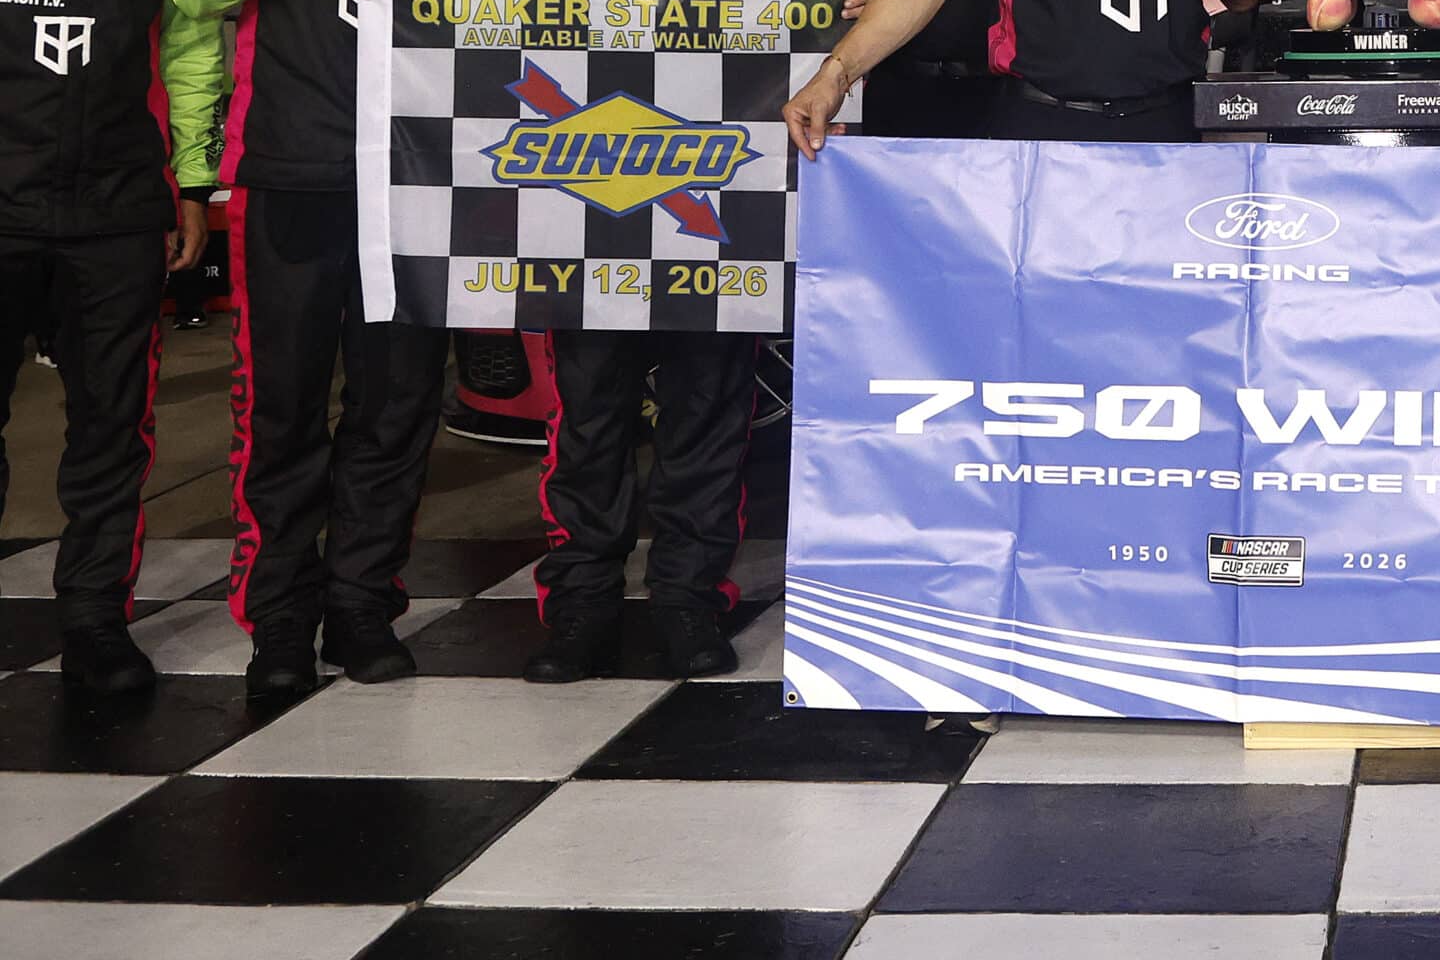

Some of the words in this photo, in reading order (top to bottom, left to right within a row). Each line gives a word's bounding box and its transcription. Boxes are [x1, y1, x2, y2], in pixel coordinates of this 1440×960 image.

[757, 0, 834, 31] 400
[463, 30, 603, 47] AVAILABLE
[611, 31, 642, 48] AT
[654, 32, 780, 51] WALMART
[1354, 34, 1408, 49] WINNER
[1219, 101, 1258, 116] BUSCH
[1297, 93, 1358, 116] Coca-Cola
[505, 132, 738, 177] SUNOCO
[1214, 197, 1310, 243] Ford
[464, 262, 577, 294] JULY
[592, 264, 653, 302] 12,
[668, 265, 768, 297] 2026
[1171, 262, 1350, 282] RACING
[868, 379, 1201, 441] 750
[1251, 472, 1406, 494] RACE
[1107, 544, 1170, 561] 1950
[1233, 538, 1291, 556] NASCAR
[1221, 560, 1245, 576] CUP
[1247, 560, 1289, 576] SERIES
[1342, 552, 1408, 570] 2026
